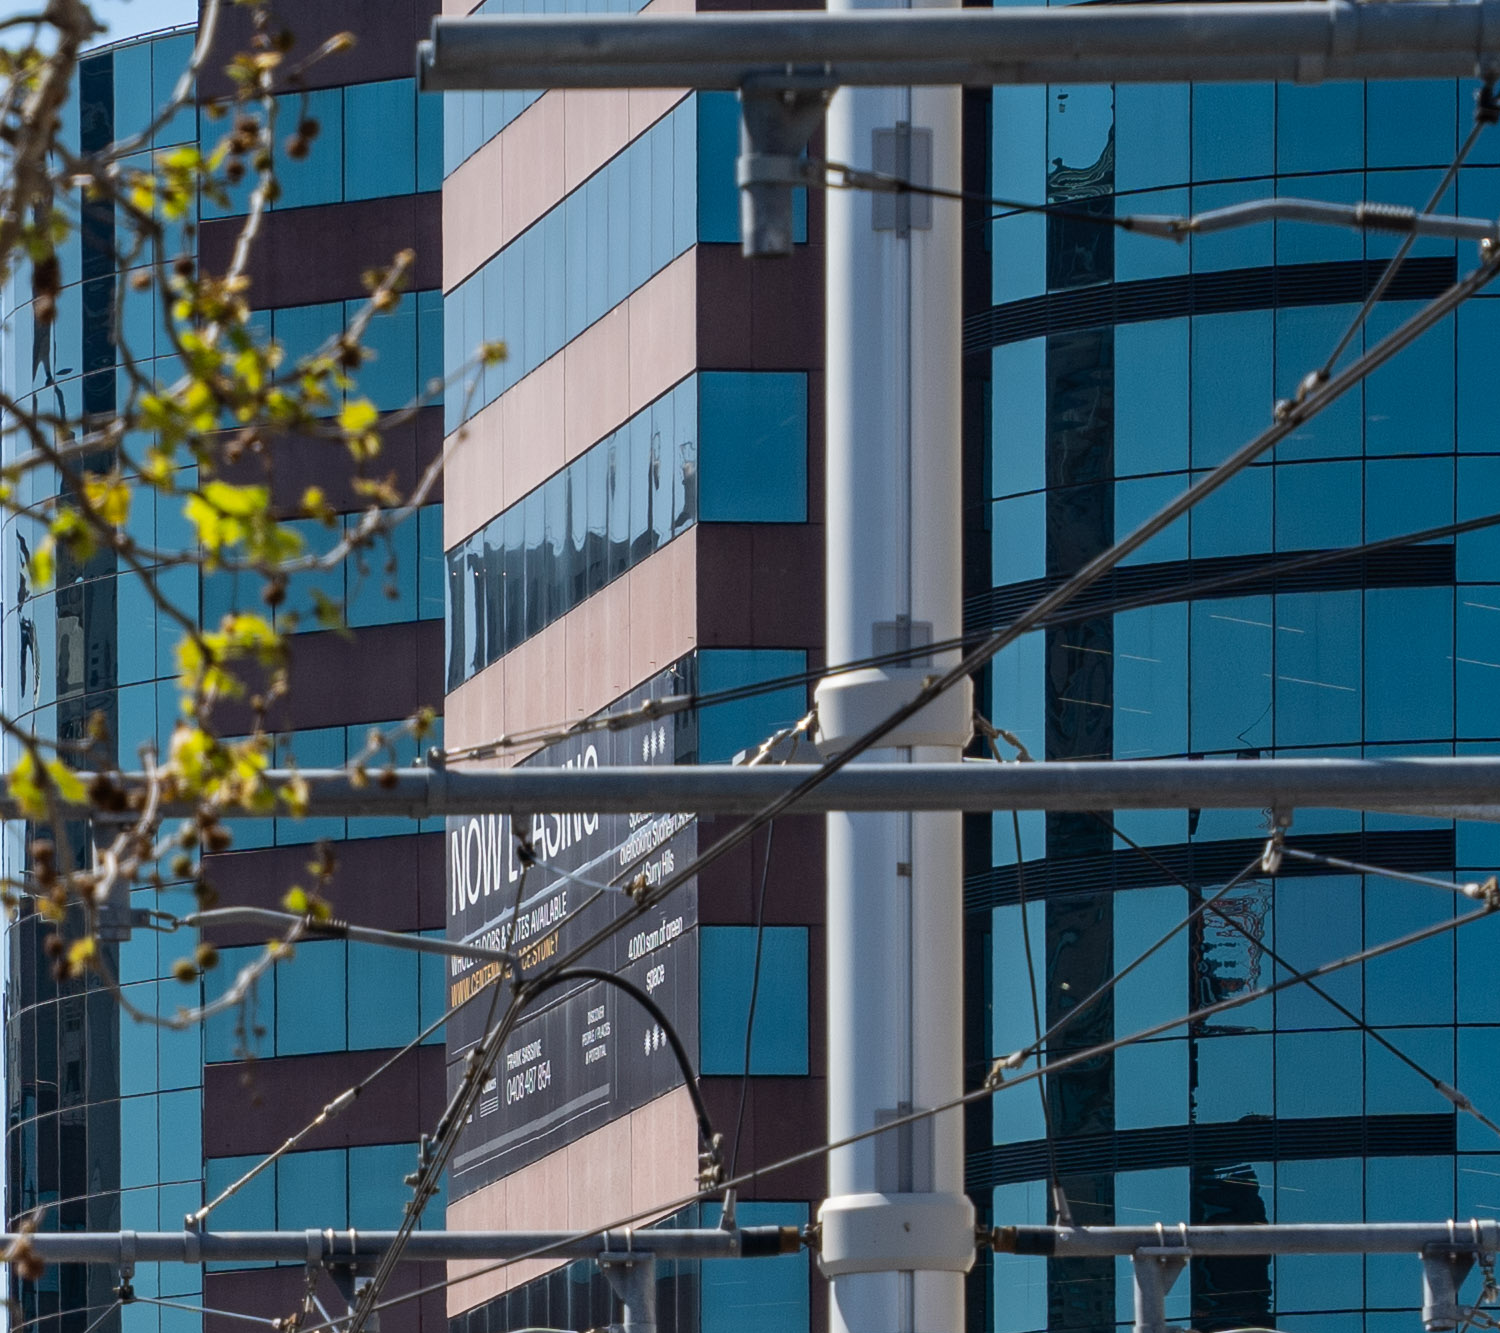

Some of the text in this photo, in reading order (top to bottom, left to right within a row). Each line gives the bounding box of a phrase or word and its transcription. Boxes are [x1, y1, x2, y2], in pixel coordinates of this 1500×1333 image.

[452, 812, 502, 916] NOW
[531, 891, 567, 937] AVAILABLE
[646, 964, 664, 994] space
[507, 1073, 524, 1105] 0408
